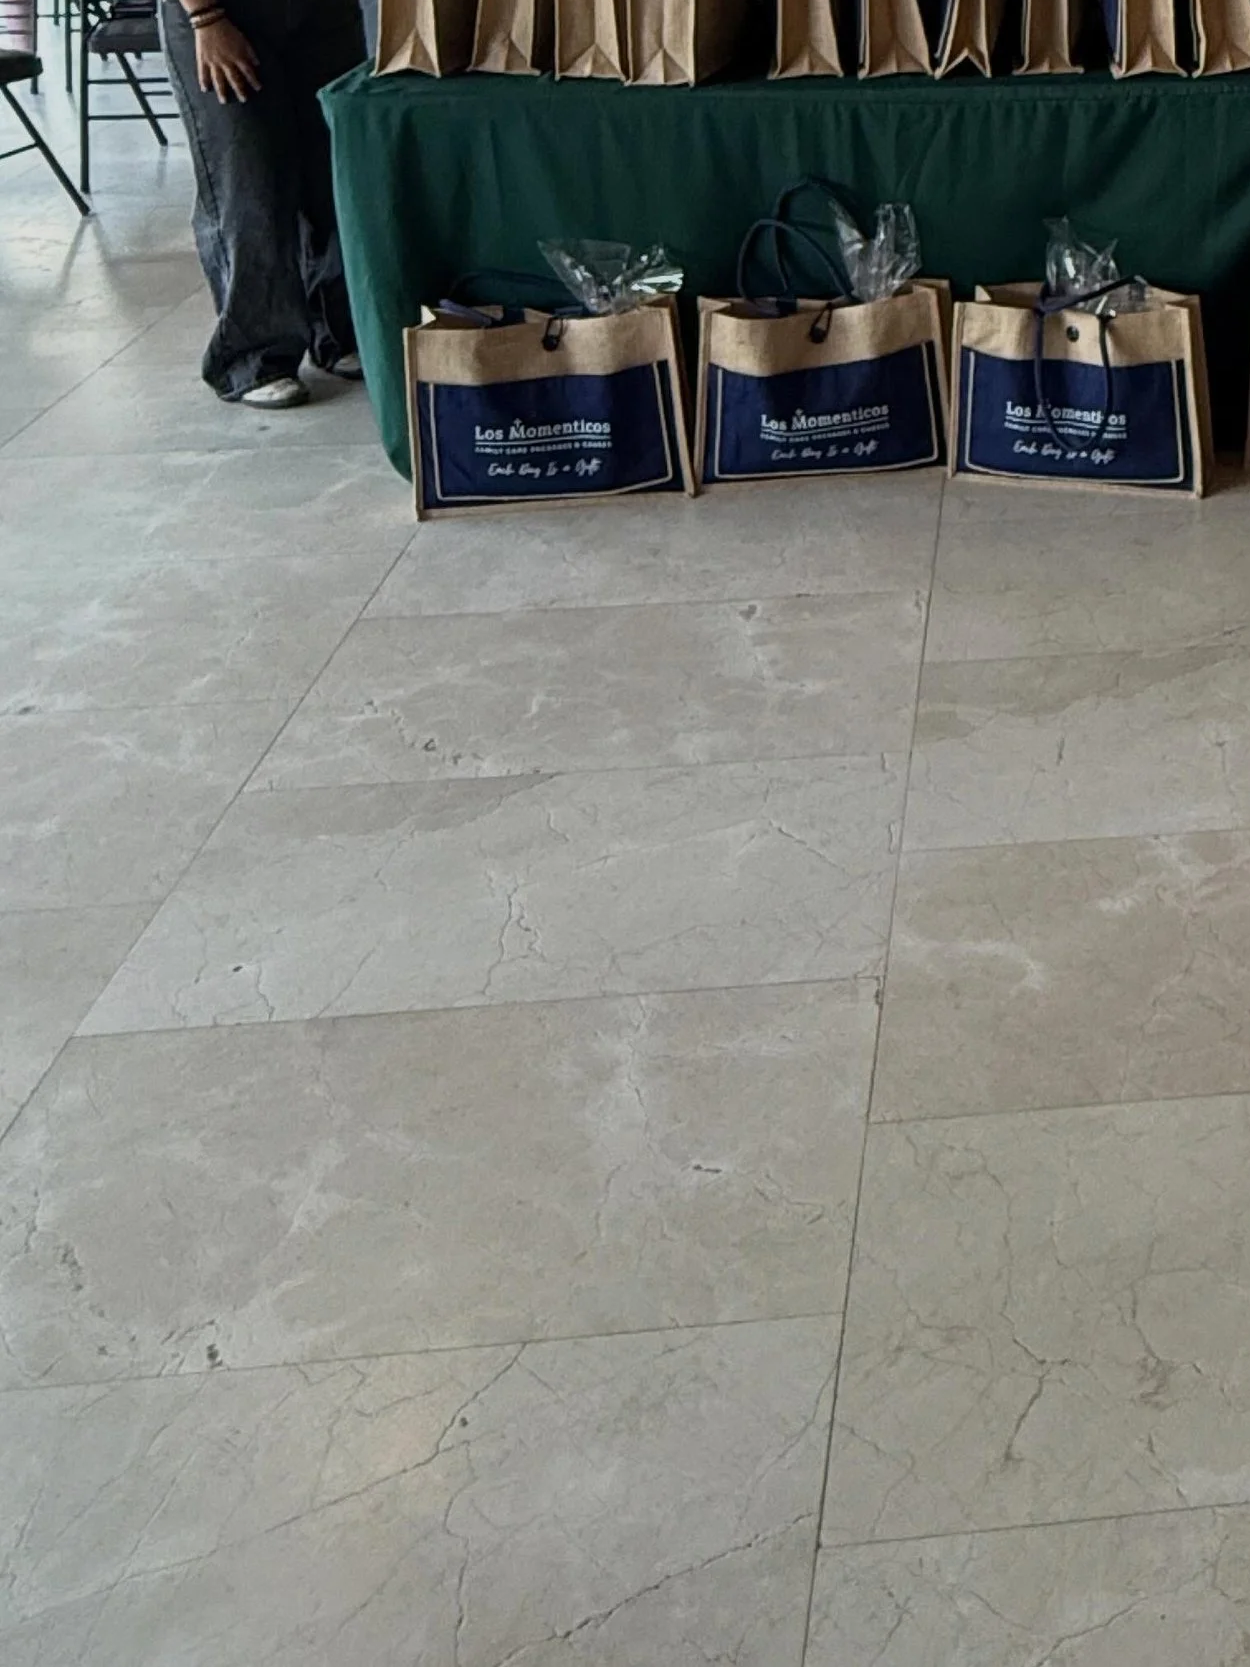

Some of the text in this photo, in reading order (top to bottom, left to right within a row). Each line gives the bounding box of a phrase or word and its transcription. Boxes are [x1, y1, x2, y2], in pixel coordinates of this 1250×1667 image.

[761, 405, 889, 431] Los Momenticos
[1005, 401, 1031, 417] Los
[475, 419, 611, 440] Los Momenticos
